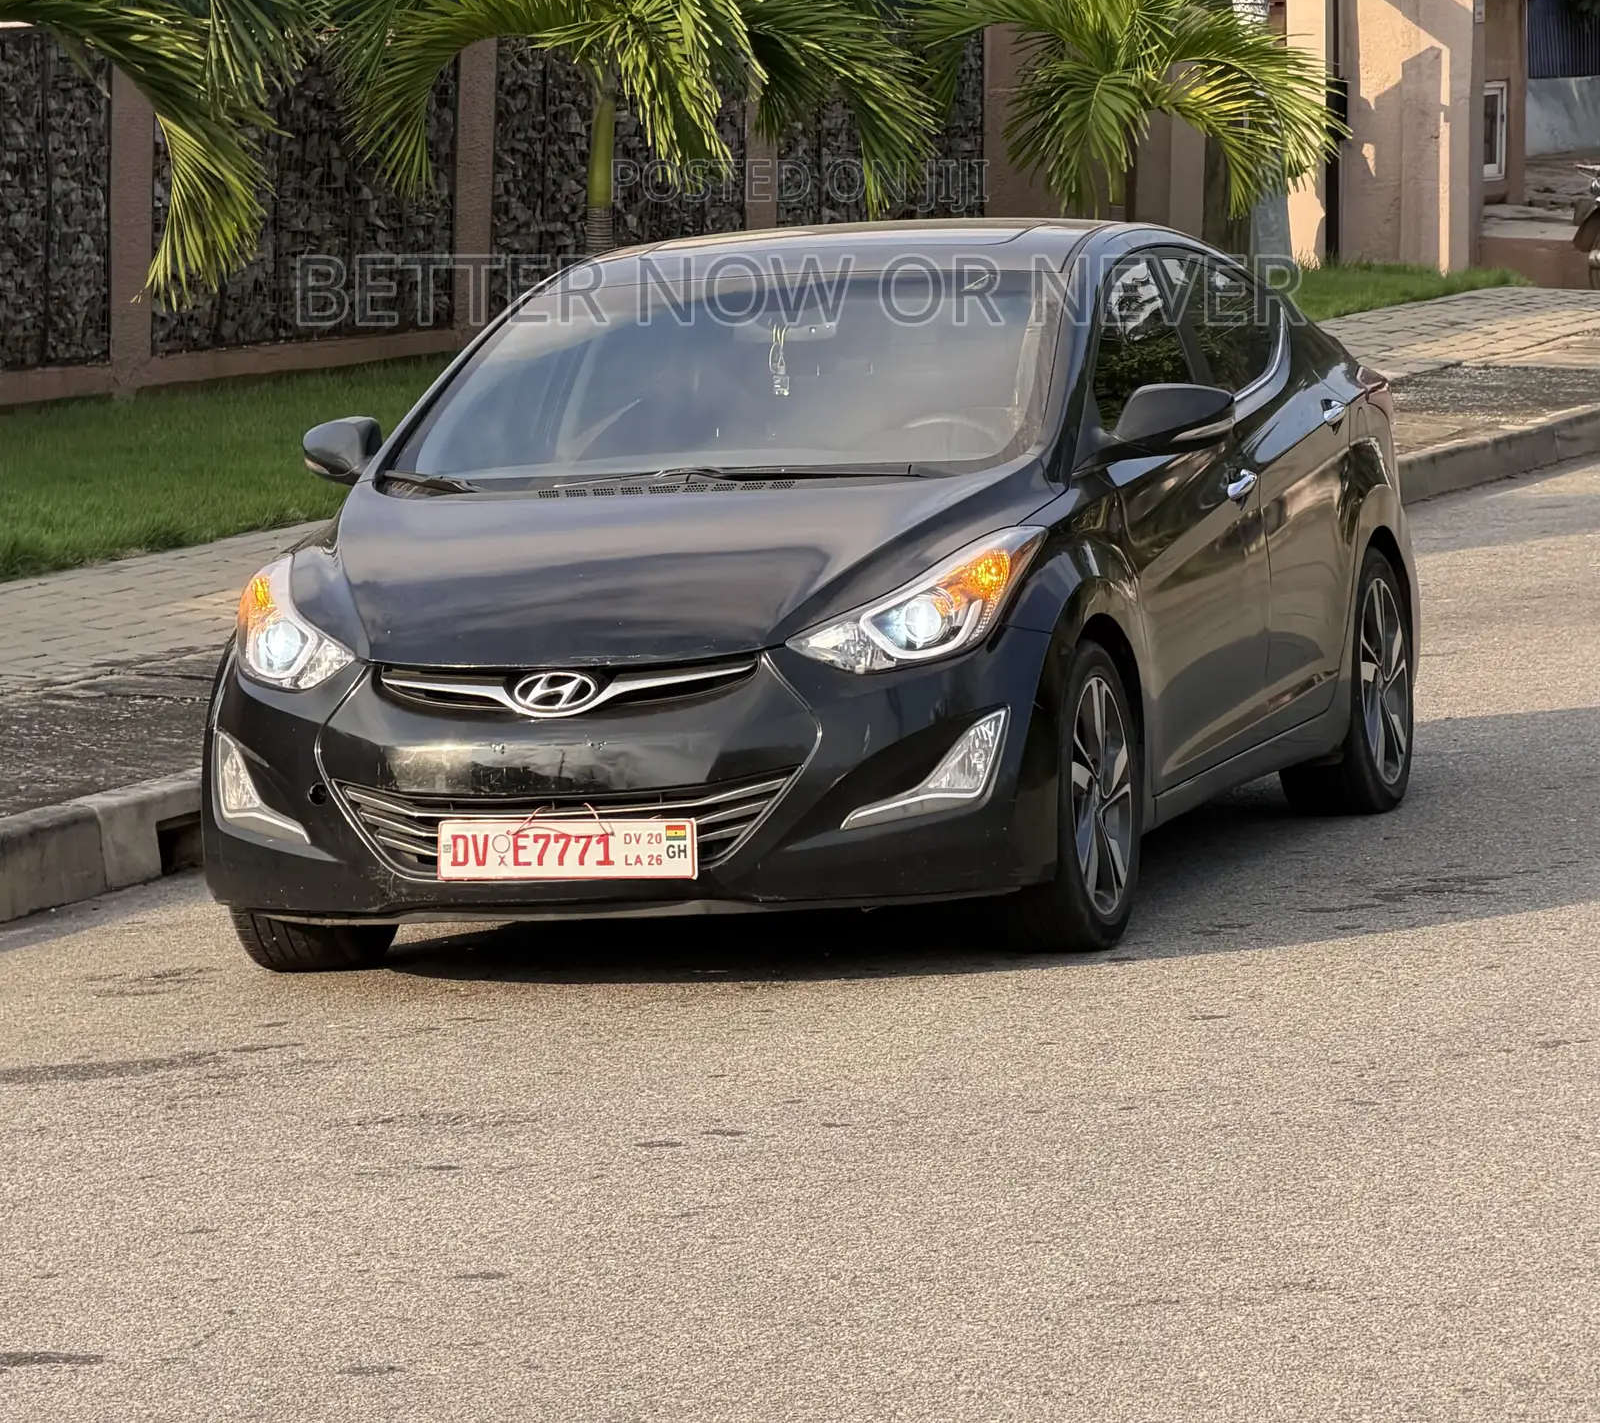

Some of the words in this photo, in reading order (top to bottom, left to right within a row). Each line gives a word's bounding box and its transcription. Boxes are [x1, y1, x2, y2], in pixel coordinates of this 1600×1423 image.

[623, 832, 642, 845] DV
[647, 832, 662, 844] 20
[450, 834, 489, 867] DV
[512, 833, 615, 867] E7771
[666, 844, 688, 859] GH
[625, 854, 643, 866] LA
[648, 853, 663, 866] 26
